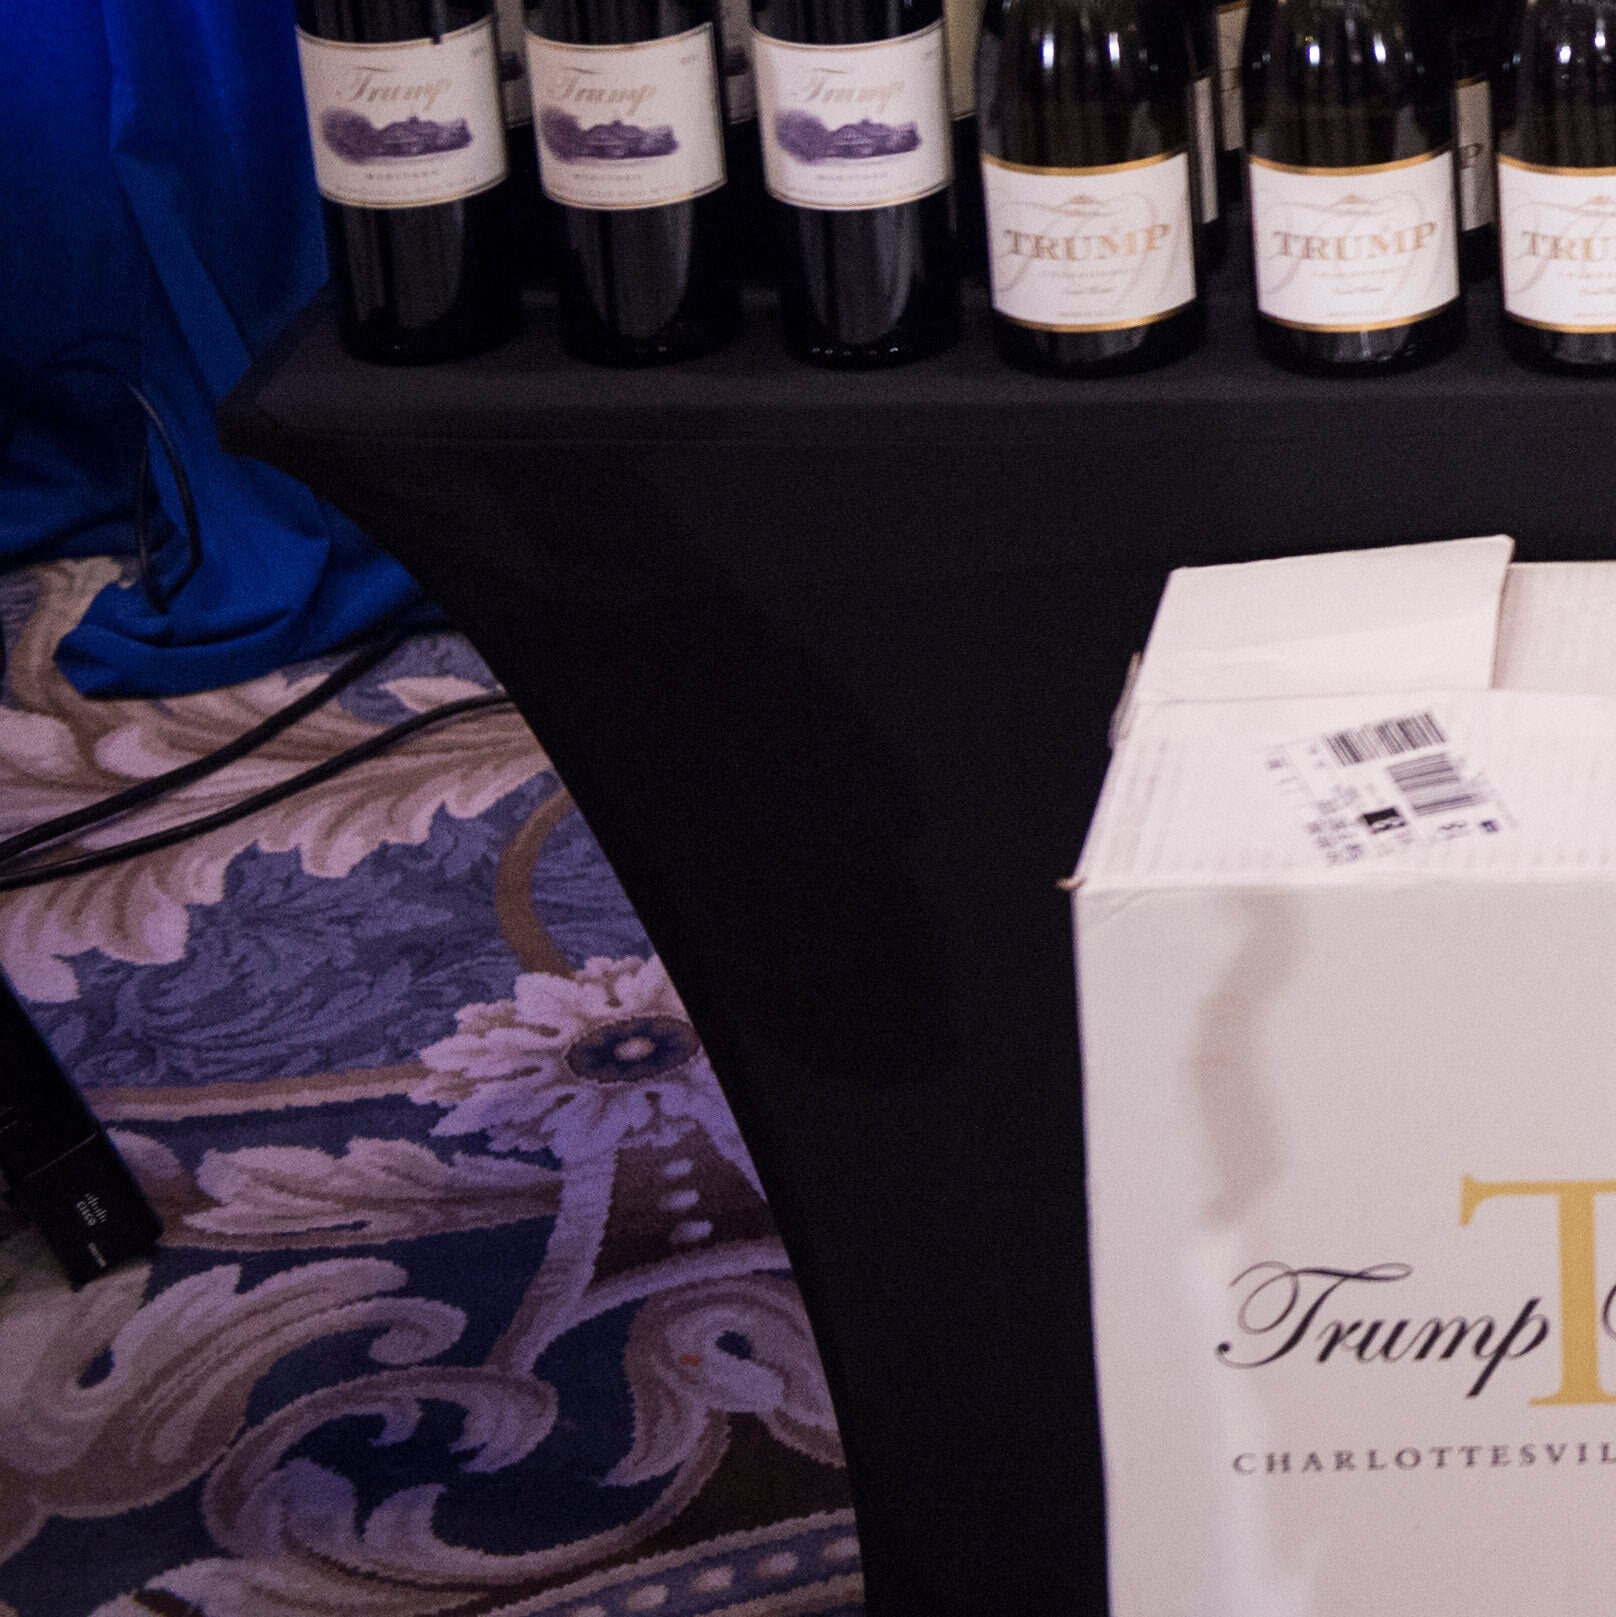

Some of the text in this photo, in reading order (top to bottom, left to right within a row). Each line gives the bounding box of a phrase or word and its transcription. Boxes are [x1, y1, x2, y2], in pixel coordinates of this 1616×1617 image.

[1003, 223, 1172, 262] TRUMP
[1272, 221, 1437, 262] TRUMP
[1215, 1260, 1550, 1399] Trump
